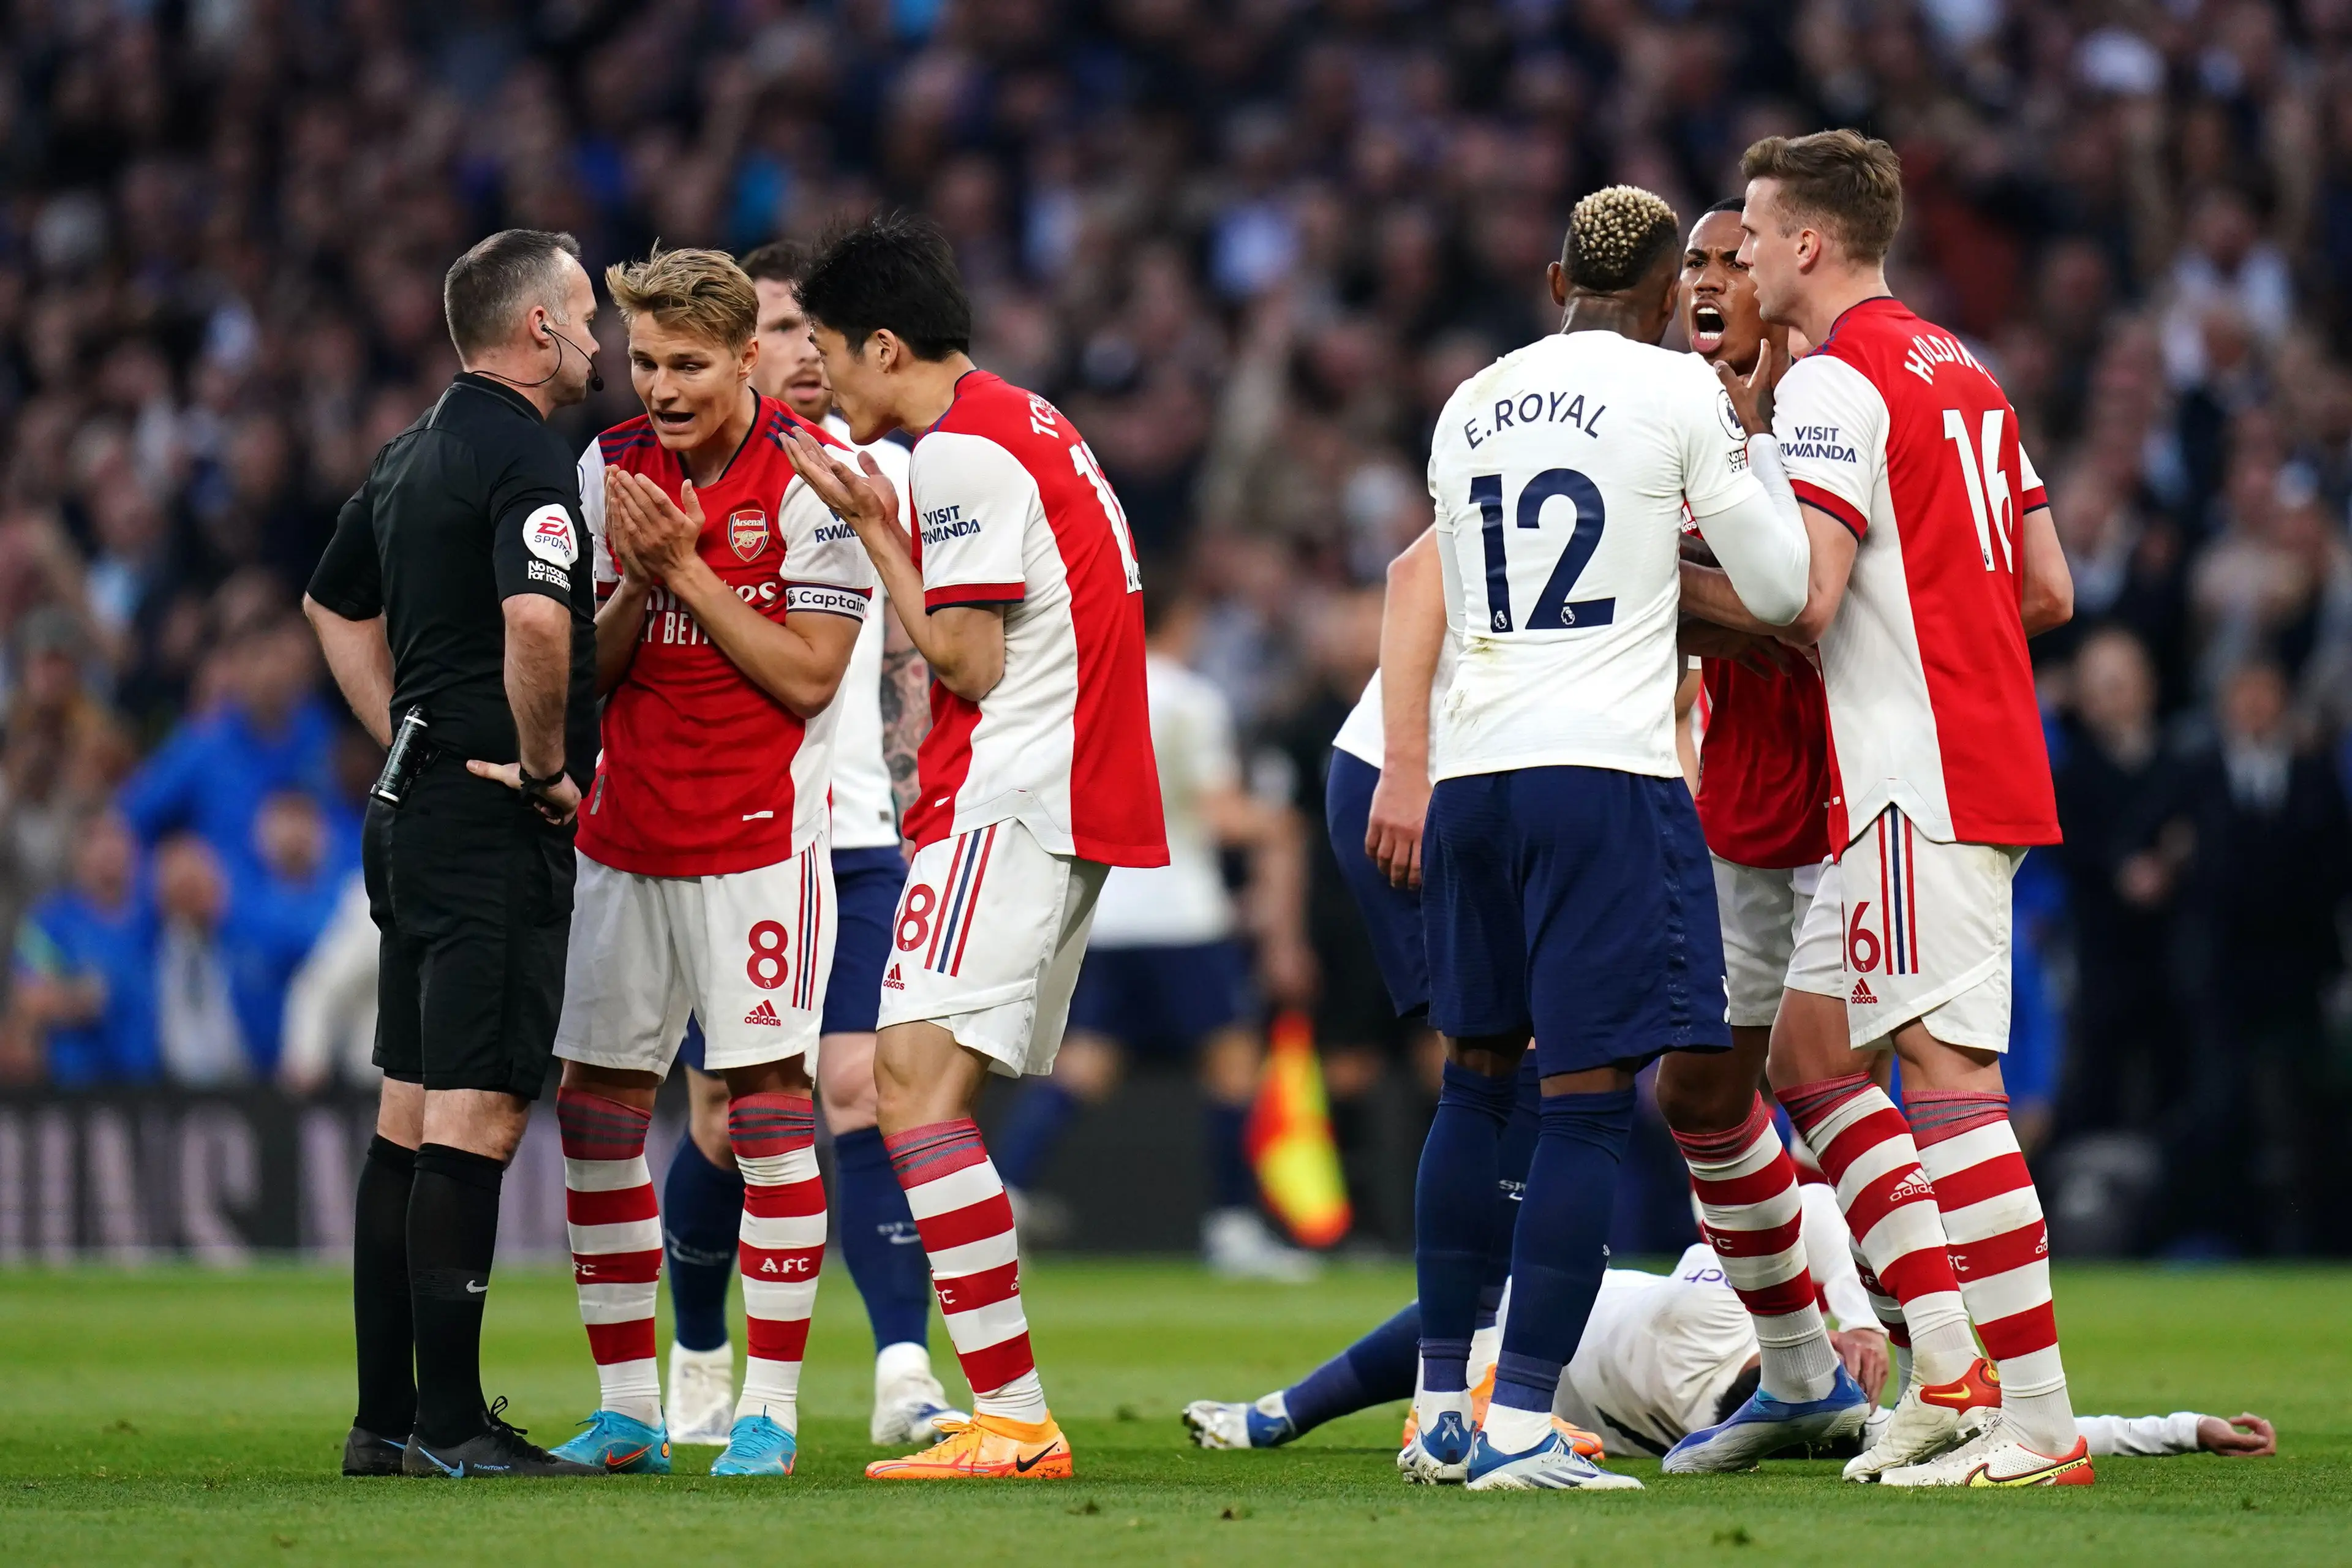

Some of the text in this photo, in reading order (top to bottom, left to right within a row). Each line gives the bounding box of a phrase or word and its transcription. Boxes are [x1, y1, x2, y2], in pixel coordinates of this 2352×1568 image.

[1904, 334, 2000, 389] HOLDIN
[1464, 391, 1607, 450] E.ROYAL
[1795, 426, 1839, 442] VISIT
[1780, 443, 1857, 463] RWANDA
[1942, 409, 2014, 575] 16
[734, 518, 764, 527] Arsenal
[922, 505, 960, 526] VISIT
[537, 516, 572, 551] EA
[921, 519, 981, 546] RWANDA
[1468, 467, 1616, 633] 12
[528, 560, 568, 582] No room
[799, 590, 865, 614] Captain
[746, 919, 788, 990] 8
[1850, 993, 1878, 1005] adidas
[744, 1016, 782, 1027] adidas
[1889, 1182, 1936, 1202] adid
[760, 1257, 810, 1274] AFC
